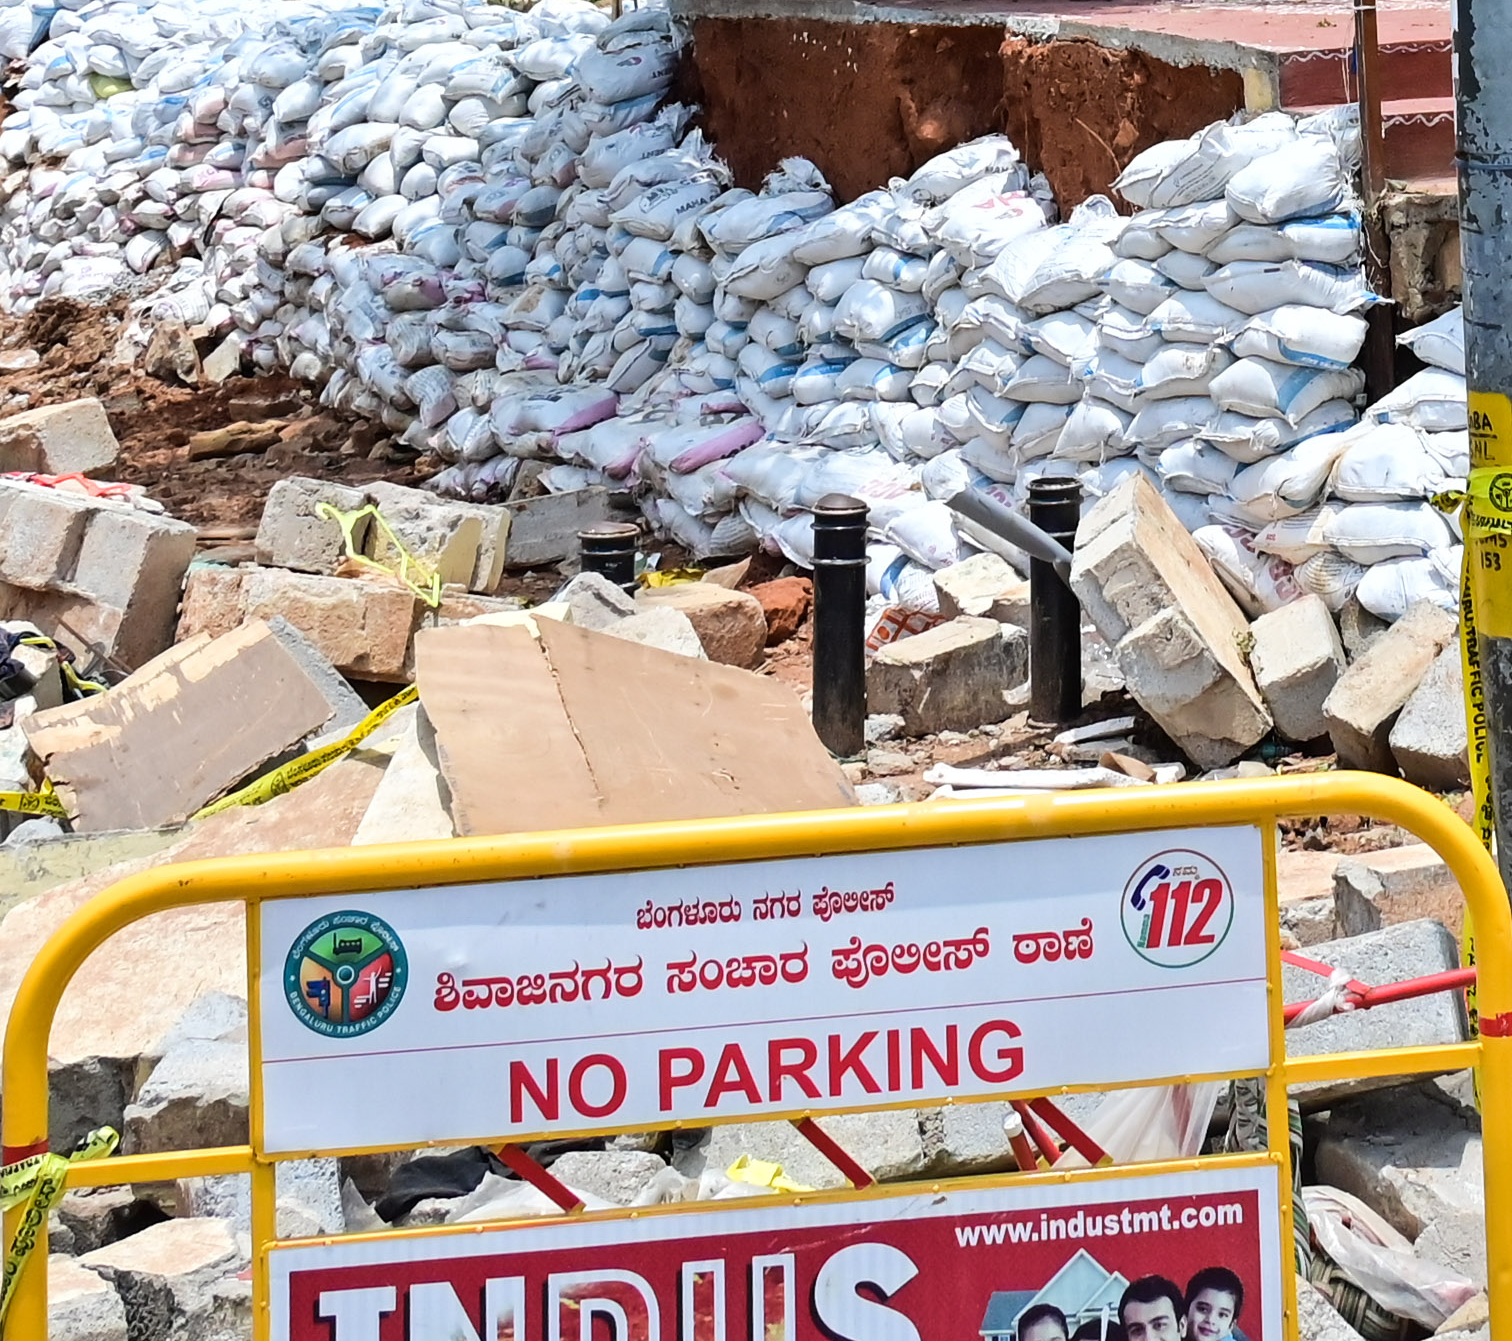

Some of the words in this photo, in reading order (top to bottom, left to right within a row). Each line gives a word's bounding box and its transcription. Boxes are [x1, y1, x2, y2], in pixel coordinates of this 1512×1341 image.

[1467, 625, 1483, 699] TRAFFIC
[637, 894, 742, 930] ಬೆಂಗಳೂರು
[753, 888, 801, 921] ನಗರ
[812, 881, 894, 922] ಪೊಲೀಸ್
[1146, 878, 1223, 949] 112
[434, 954, 644, 1012] ಶಿವಾಜಿನಗರ
[667, 940, 809, 993] ಸಂಚಾರ
[831, 927, 989, 989] ಪೊಲೀಸ್
[1013, 917, 1094, 964] ಠಾಣೆ
[289, 991, 334, 1033] BENGALURU
[336, 1017, 378, 1034] TRAFFIC
[377, 986, 402, 1019] POLICE
[509, 1054, 628, 1124] NO
[658, 1019, 1025, 1112] PARKING
[954, 1200, 1244, 1249] www.industmt.com
